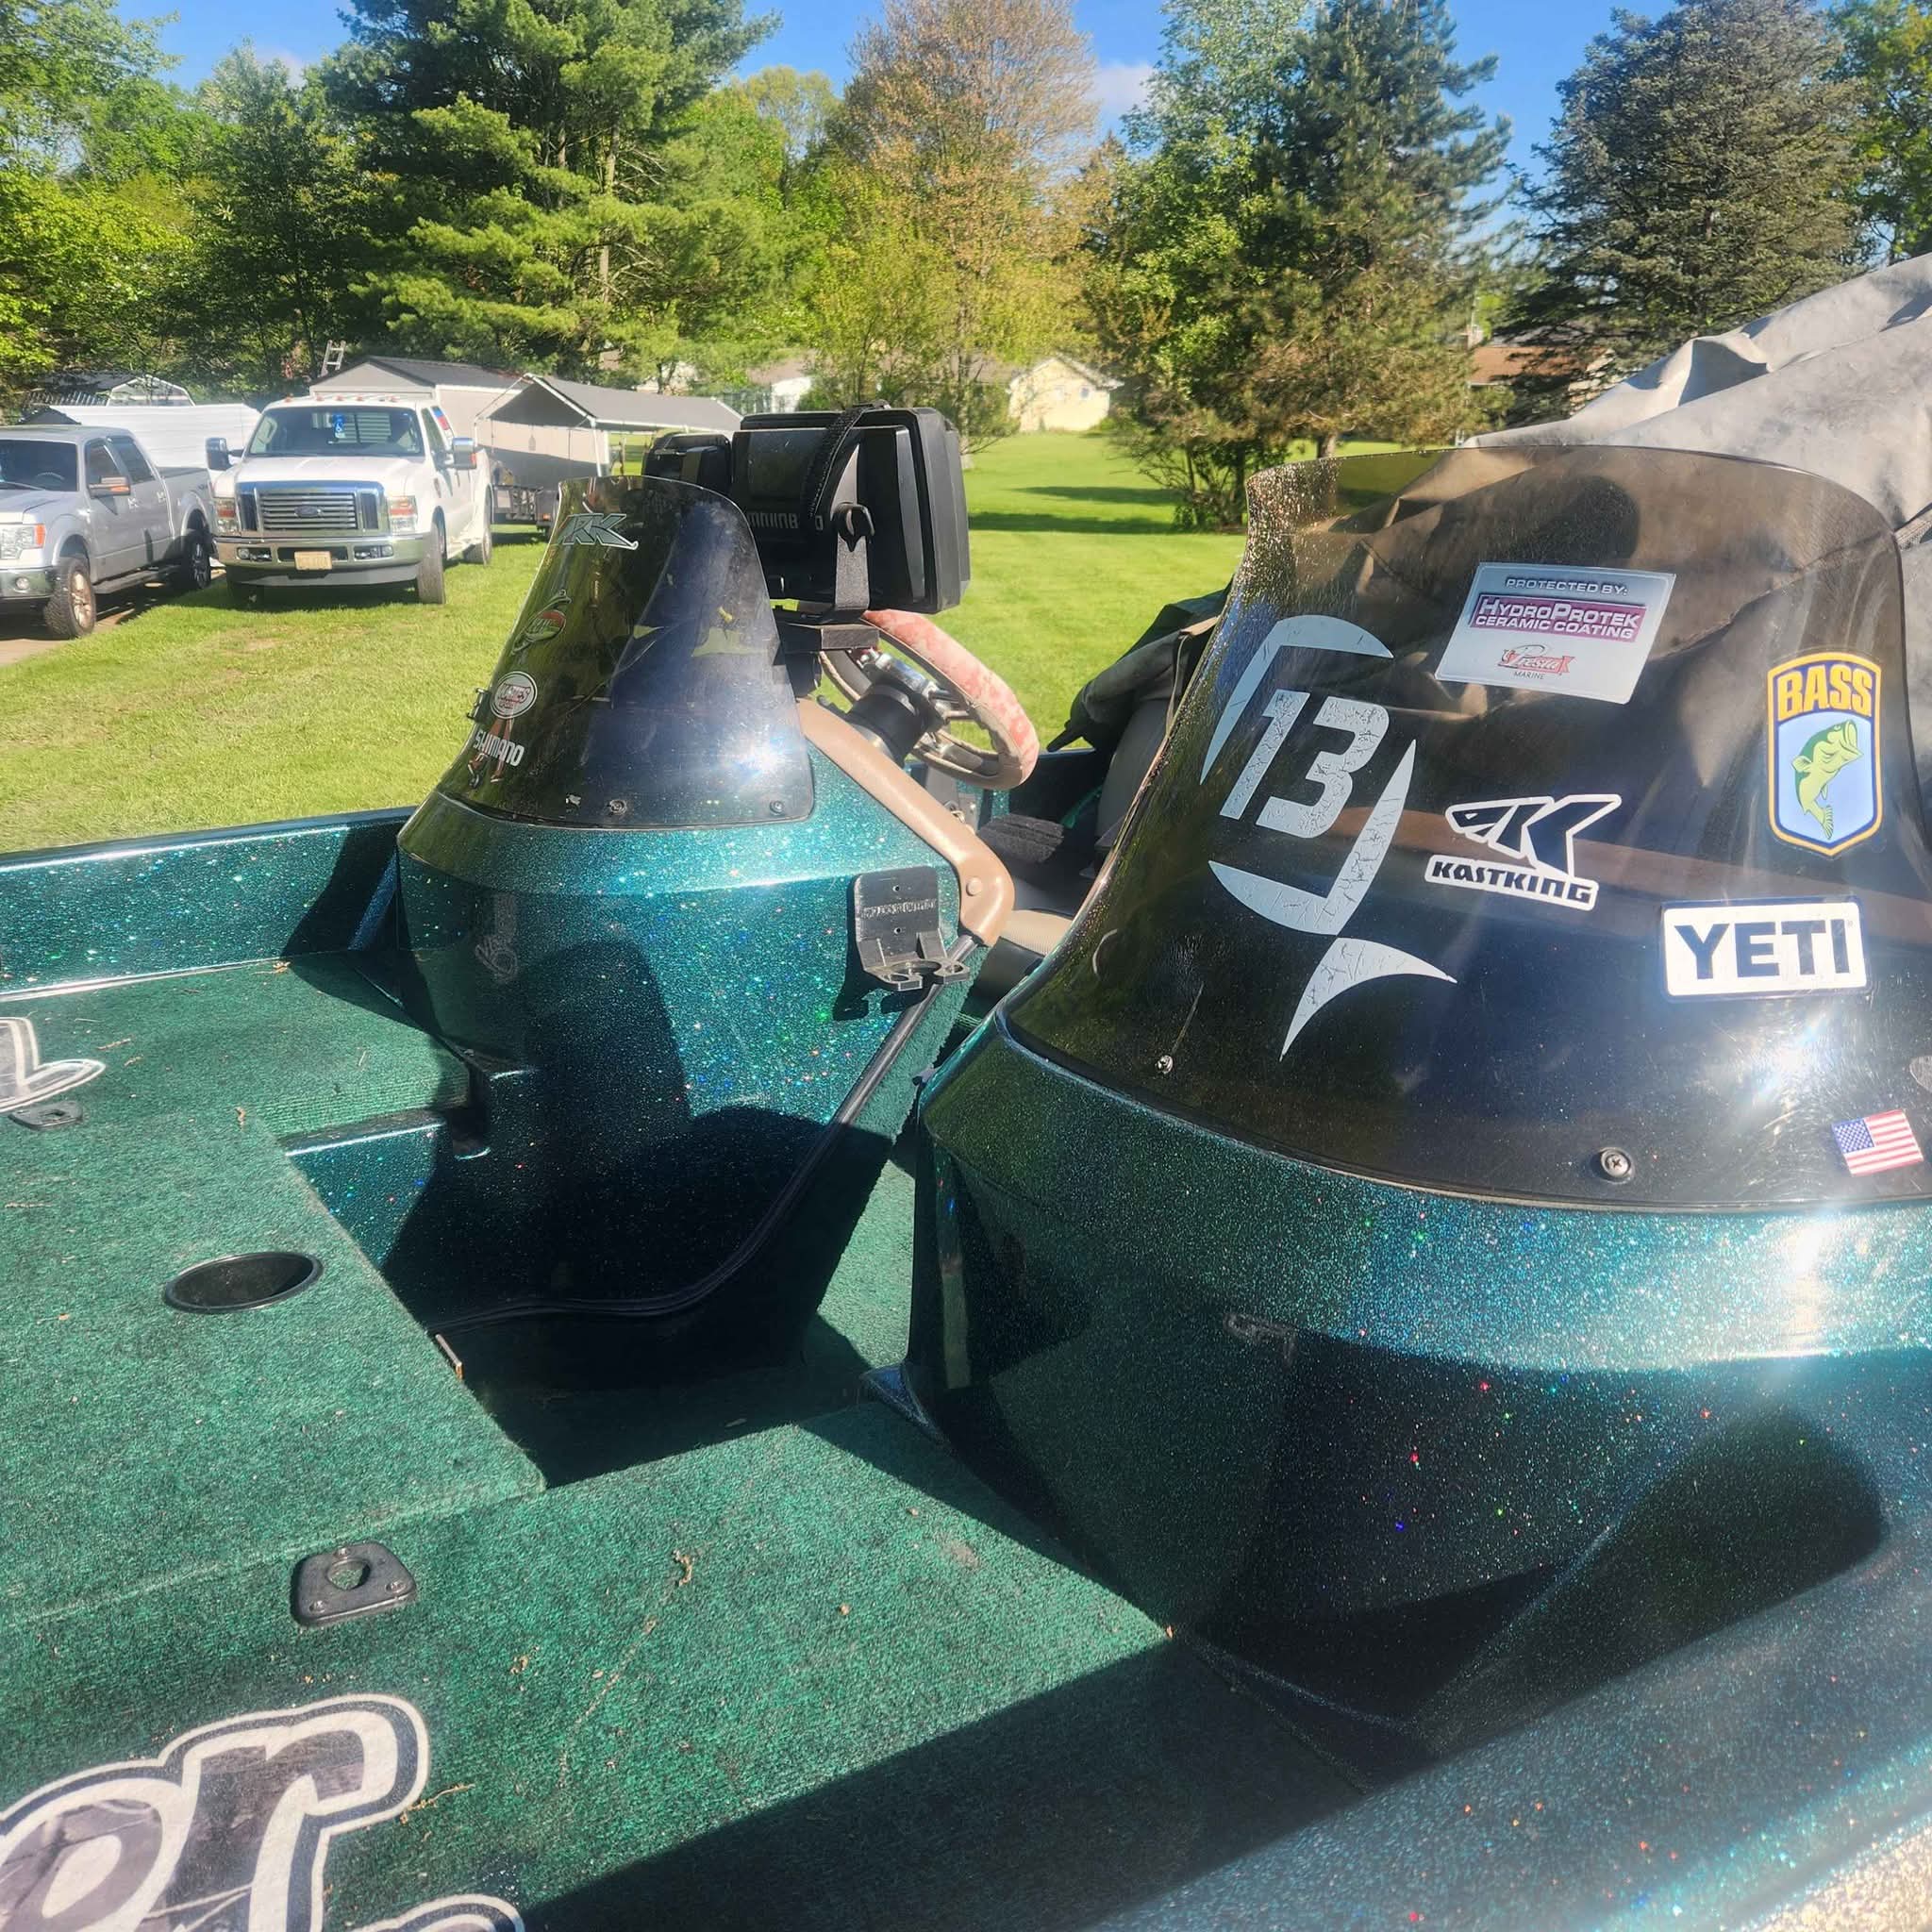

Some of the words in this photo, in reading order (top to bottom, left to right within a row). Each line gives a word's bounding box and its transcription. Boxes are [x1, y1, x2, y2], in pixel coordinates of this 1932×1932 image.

[1505, 577, 1598, 593] PROTECTED
[1602, 584, 1628, 596] BY:
[1474, 615, 1551, 631] CERAMIC
[1554, 621, 1635, 640] COATING
[1477, 596, 1641, 628] HYDROPROTEK
[1513, 671, 1545, 680] MARINE
[474, 729, 525, 767] SHIMANO
[1219, 691, 1390, 839] 13
[1431, 860, 1593, 904] KASTKING
[1674, 918, 1852, 980] YETI
